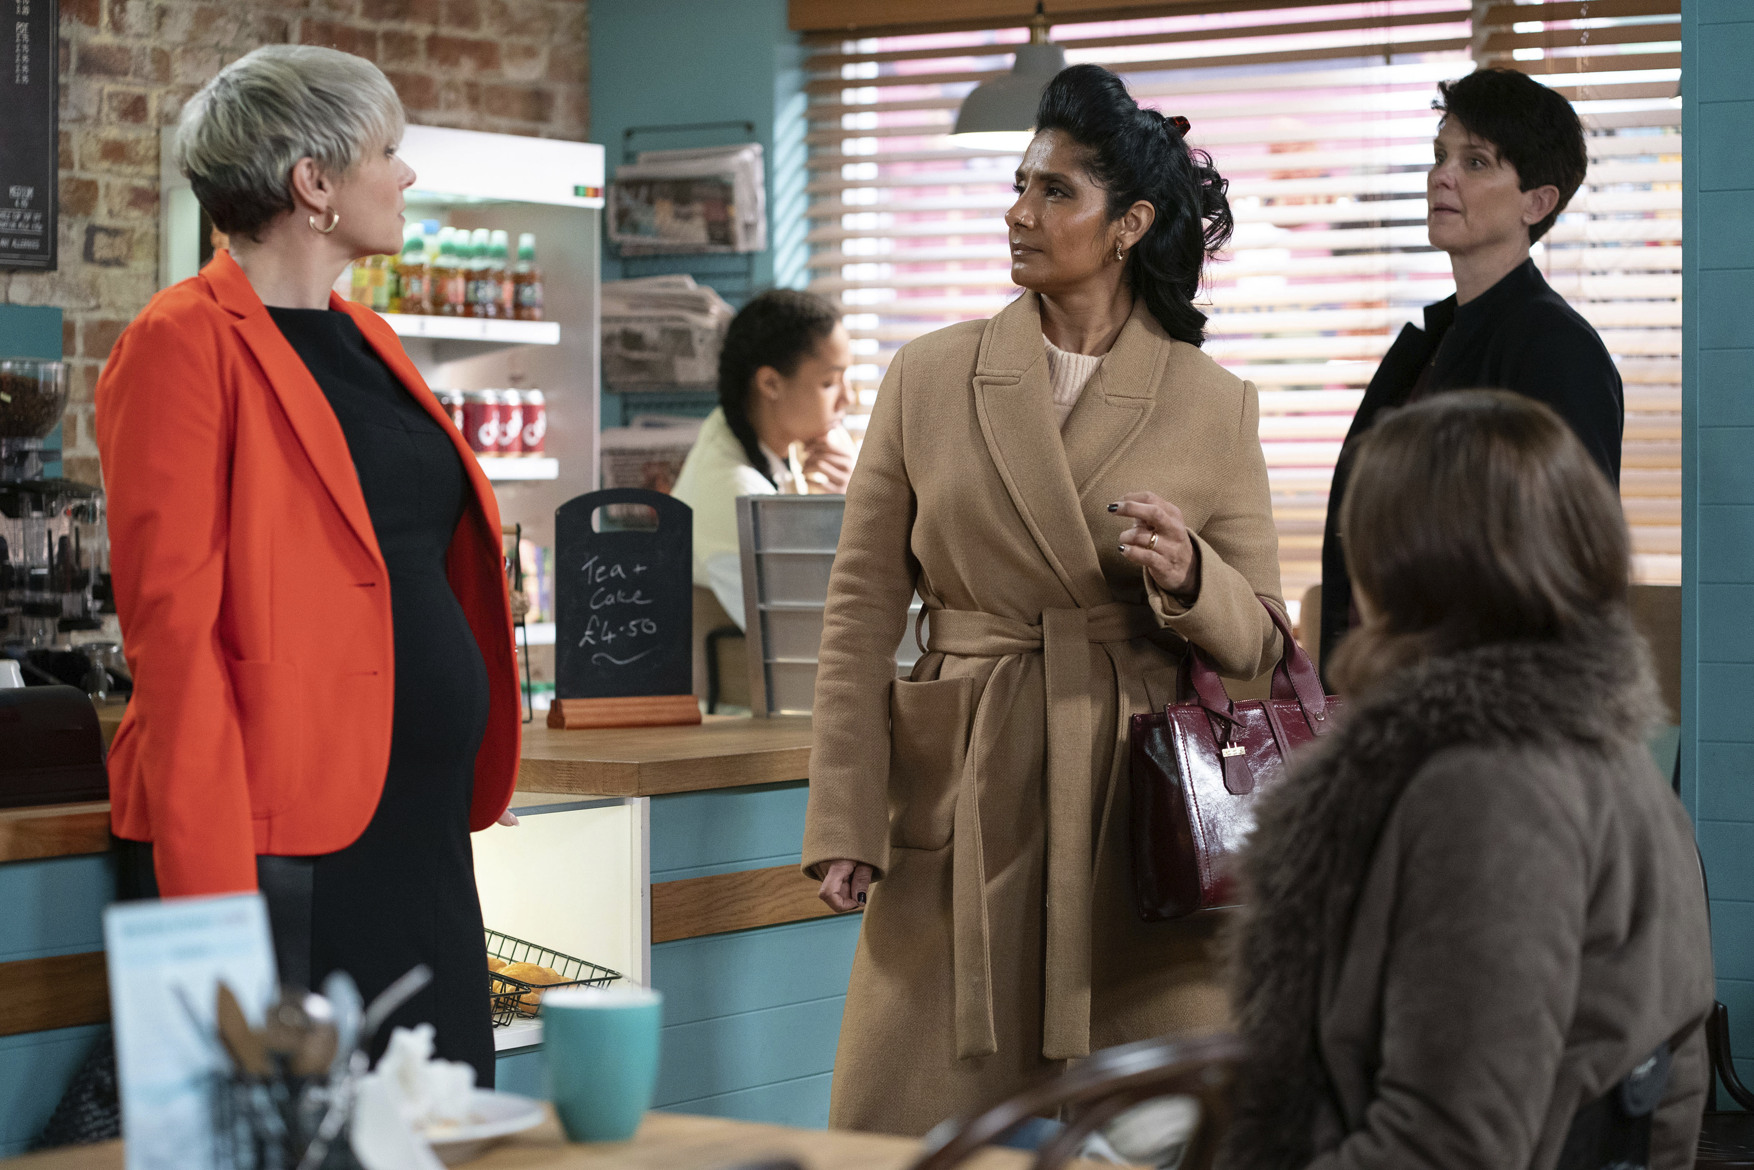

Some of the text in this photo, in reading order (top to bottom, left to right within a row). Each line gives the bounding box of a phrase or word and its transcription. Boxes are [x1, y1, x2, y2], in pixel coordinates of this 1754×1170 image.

[581, 556, 647, 584] Tea +
[590, 587, 653, 610] Cake
